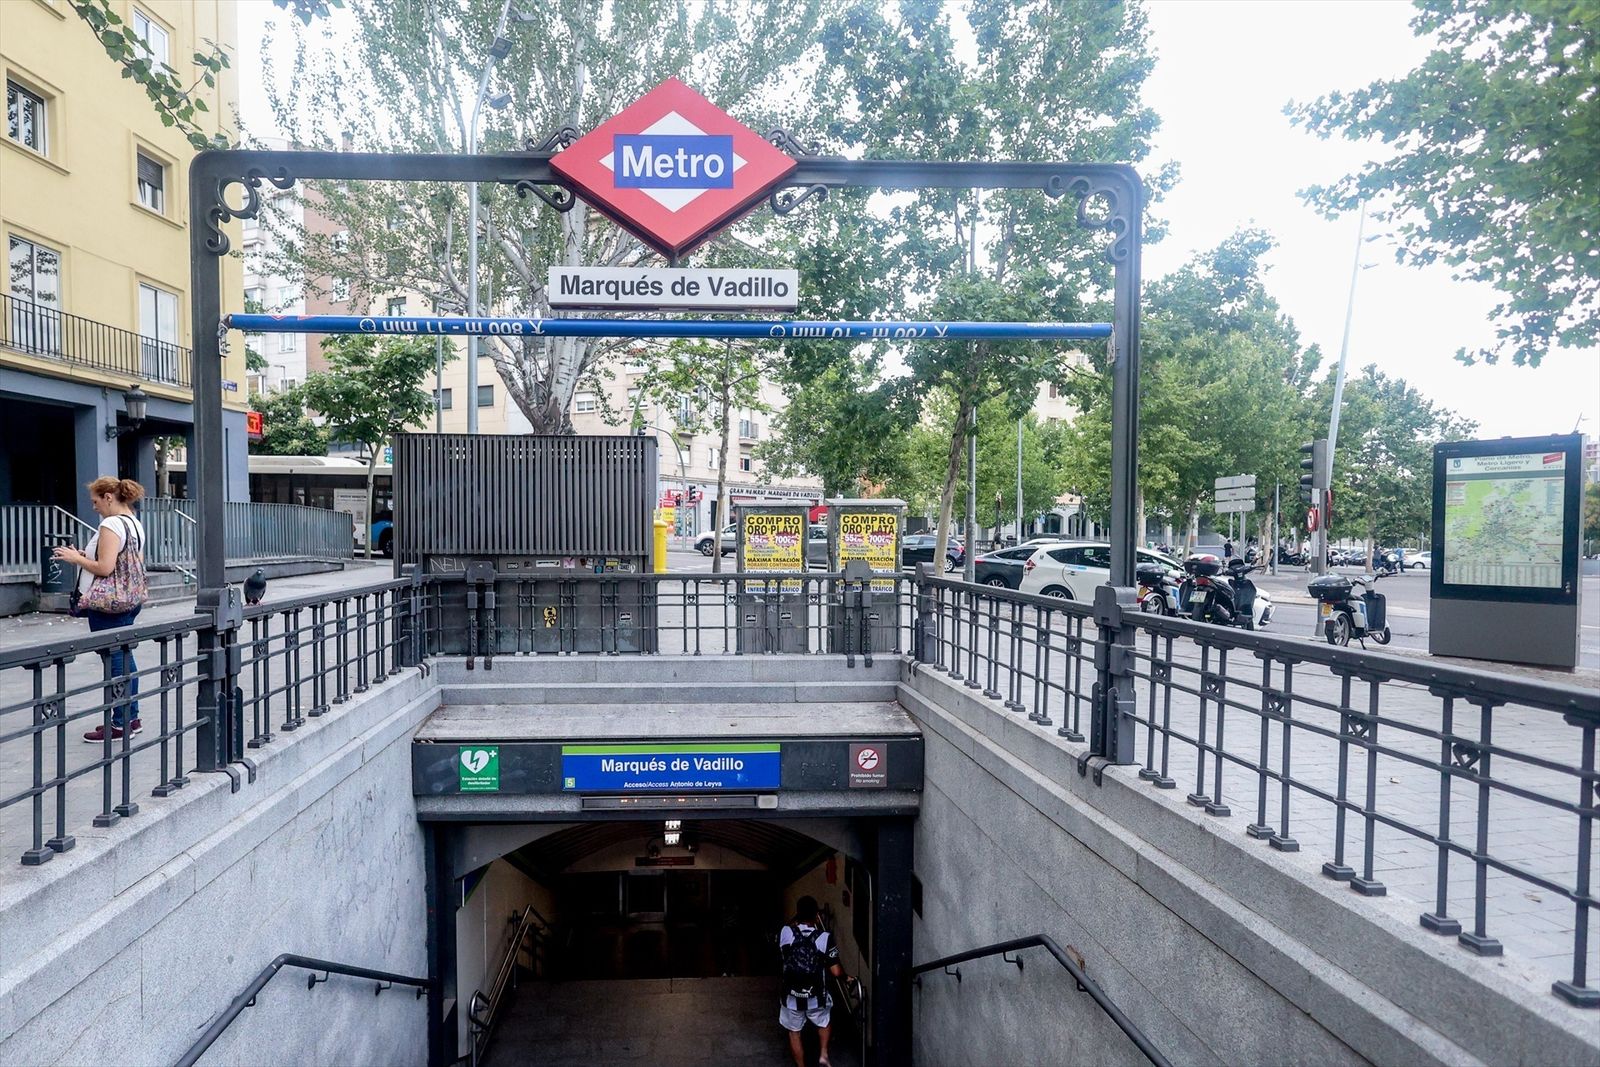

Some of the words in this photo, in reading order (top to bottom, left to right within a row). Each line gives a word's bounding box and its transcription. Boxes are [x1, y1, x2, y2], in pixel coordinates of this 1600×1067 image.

[621, 144, 725, 179] Metro
[560, 274, 663, 300] Marqués
[671, 276, 700, 296] de
[707, 276, 789, 298] Vadillo
[382, 320, 417, 332] min
[465, 321, 483, 334] m
[488, 321, 523, 335] 800
[747, 516, 801, 525] COMPRO
[842, 516, 895, 524] COMPRO
[601, 757, 666, 775] Marqués
[671, 758, 689, 771] de
[693, 757, 744, 771] Vadillo
